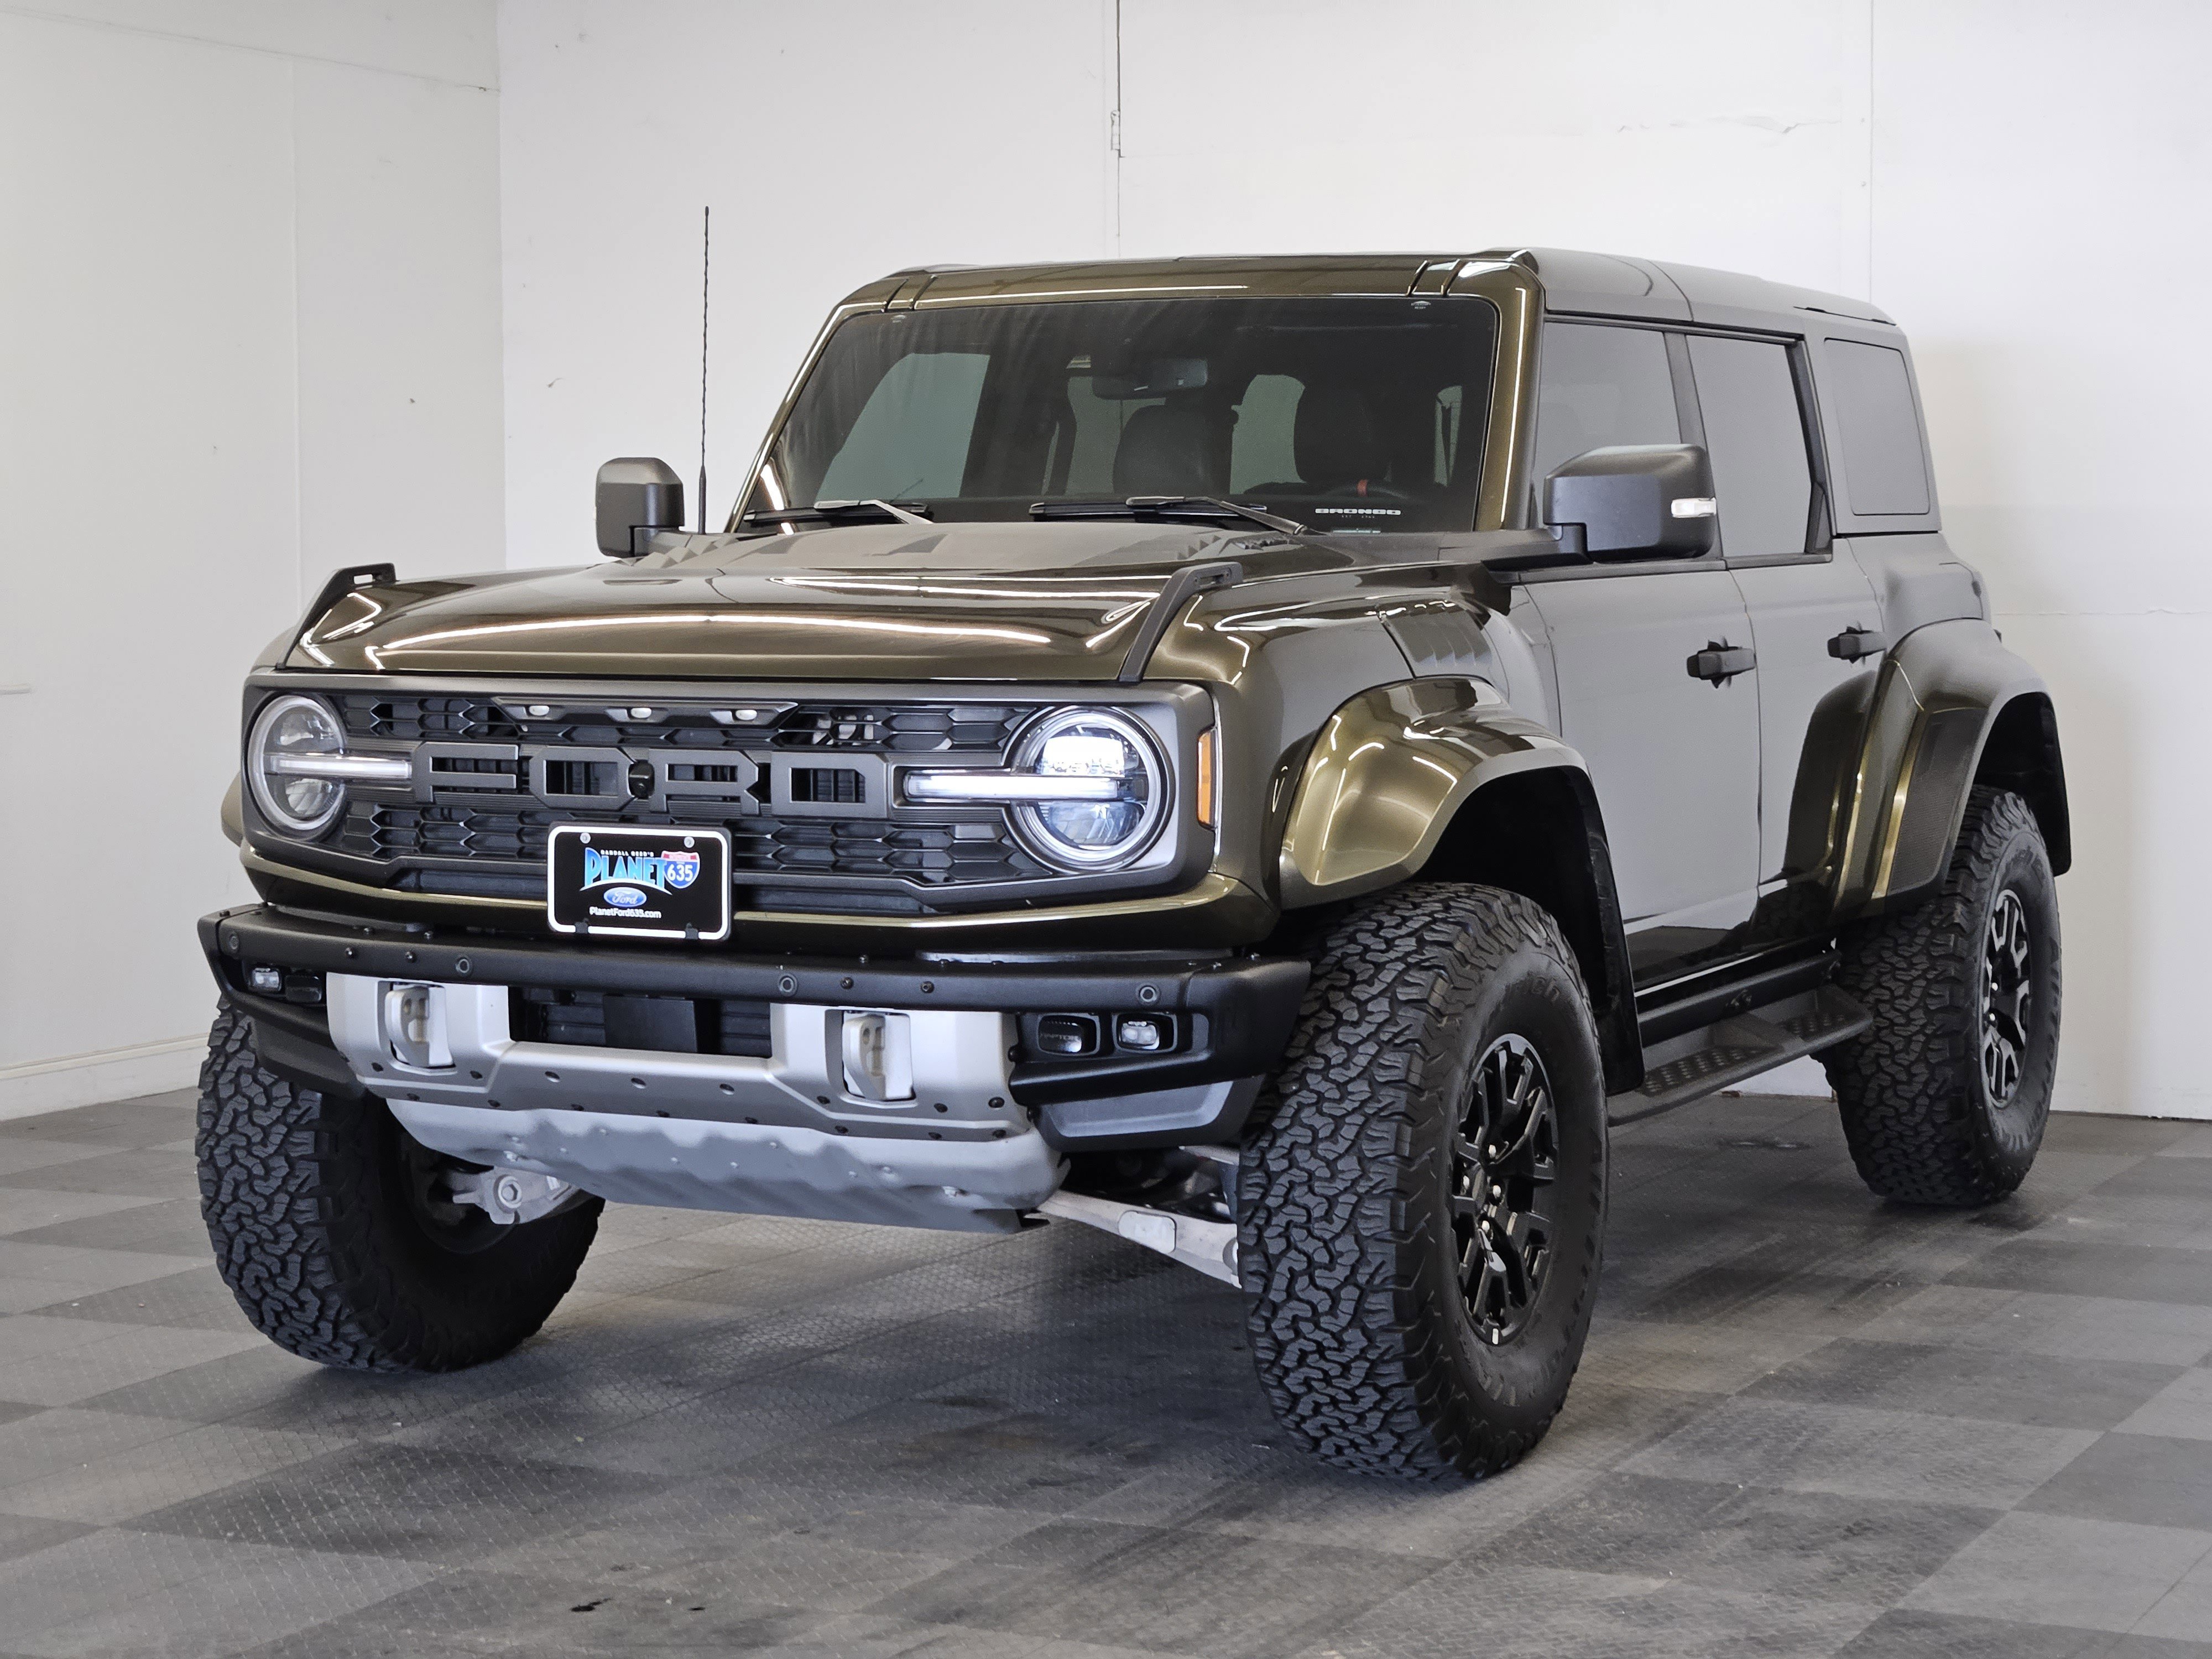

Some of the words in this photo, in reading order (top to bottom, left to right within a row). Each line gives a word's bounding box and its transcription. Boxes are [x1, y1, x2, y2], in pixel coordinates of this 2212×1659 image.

[413, 742, 886, 818] FORD
[585, 847, 667, 888] PLANET
[667, 863, 693, 882] 635
[612, 890, 638, 904] Ford
[589, 906, 662, 919] PlanetFord635.com
